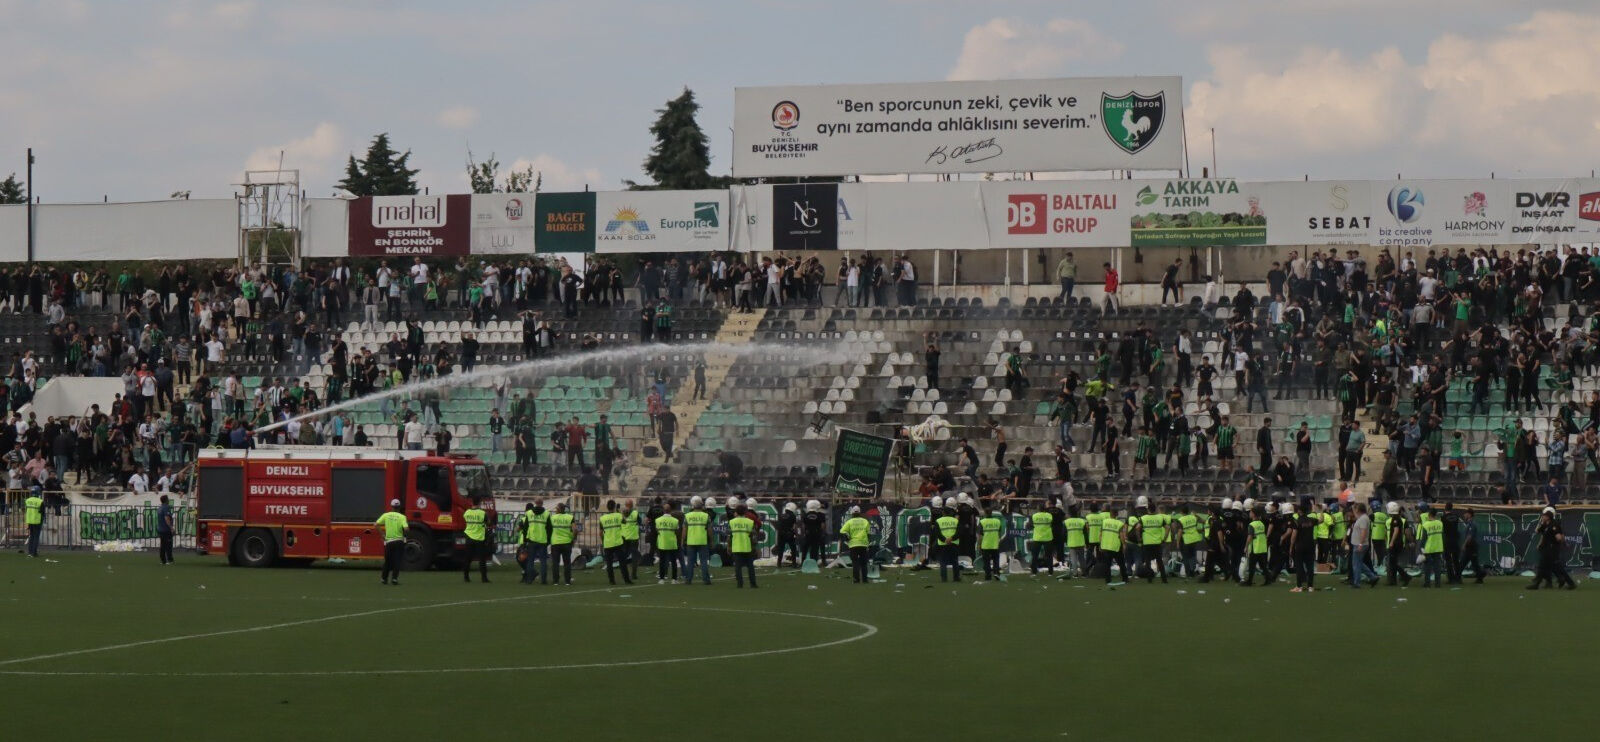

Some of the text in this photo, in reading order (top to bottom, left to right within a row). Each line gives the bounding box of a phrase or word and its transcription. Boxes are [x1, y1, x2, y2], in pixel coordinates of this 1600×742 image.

[879, 98, 962, 114] sporcunun
[967, 96, 1002, 111] zeki,
[1009, 95, 1052, 111] çevik
[1058, 97, 1077, 107] ve
[817, 121, 850, 136] aynı
[856, 118, 932, 133] zamanda
[937, 116, 1018, 133] ahlâklısını
[1163, 180, 1239, 195] AKKAYA
[1052, 194, 1117, 211] BALTALI
[1163, 196, 1210, 208] TARIM
[378, 198, 441, 225] mahal
[547, 212, 586, 222] BAGET
[546, 223, 585, 232] BURGER
[1053, 217, 1098, 233] GRUP
[1308, 216, 1370, 229] SEBAT
[1445, 220, 1506, 230] HARMONY
[1379, 227, 1432, 236] biz creative
[375, 236, 444, 246] EN BONKÖR
[1379, 238, 1432, 246] company
[385, 246, 432, 254] MEKANI
[265, 504, 308, 515] İTFAİYE
